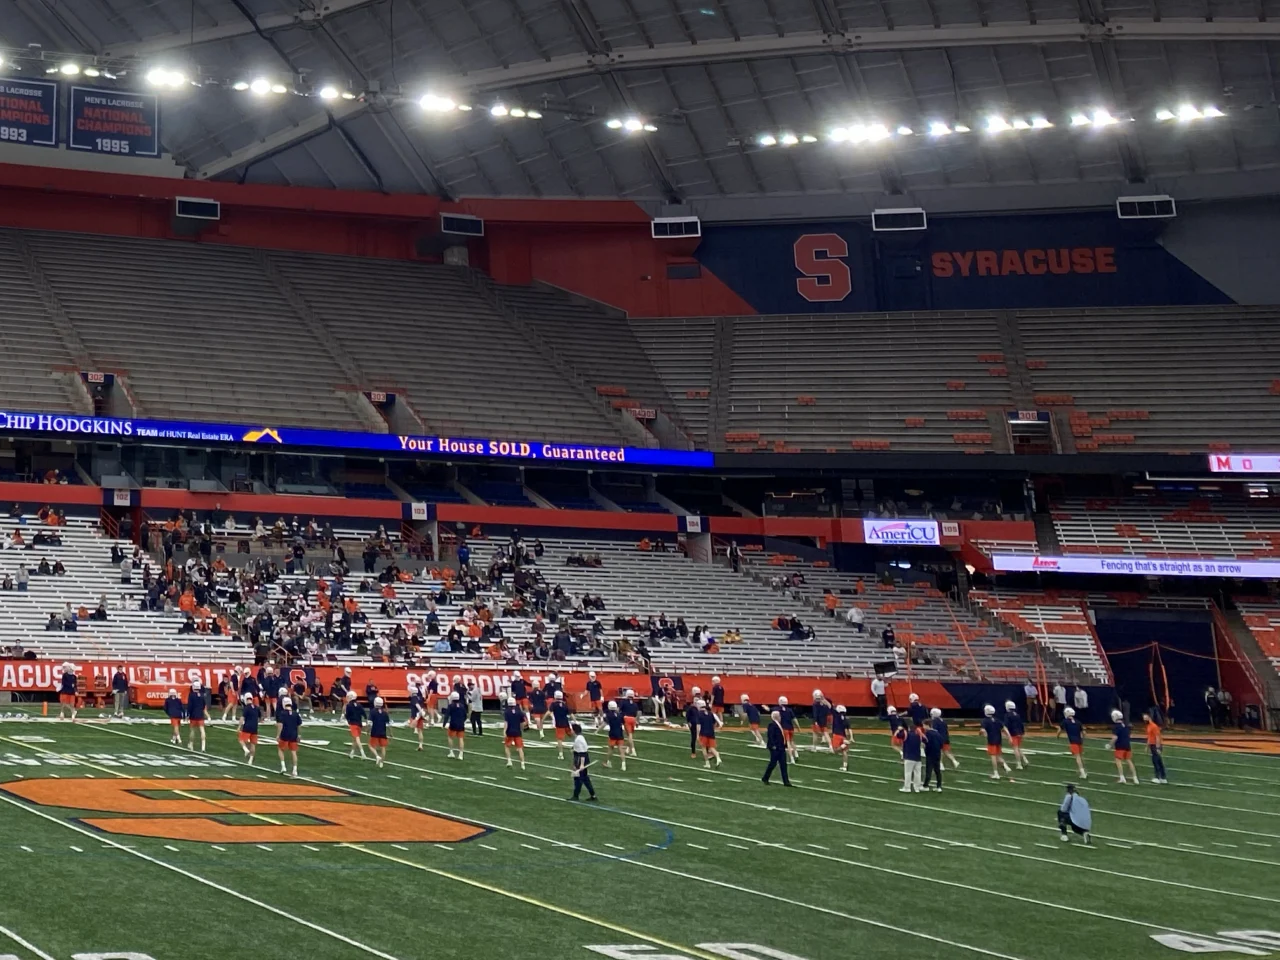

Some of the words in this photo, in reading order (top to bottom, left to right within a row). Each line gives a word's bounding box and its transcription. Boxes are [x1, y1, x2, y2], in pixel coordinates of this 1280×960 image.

[6, 86, 42, 97] LACROSSE
[84, 96, 107, 105] MEN'S
[108, 99, 144, 109] LACROSSE
[83, 107, 146, 124] NATIONAL
[76, 118, 152, 137] CHAMPIONS
[96, 138, 130, 154] 1995
[793, 233, 852, 302] S
[931, 246, 1118, 278] SYRACUSE
[88, 374, 103, 382] 302
[372, 393, 386, 401] 303
[136, 428, 158, 437] TEAM
[166, 430, 186, 438] HUNT
[188, 431, 200, 439] Real
[202, 432, 219, 440] Estate
[220, 433, 234, 441] ERA
[399, 436, 433, 451] Your
[439, 438, 483, 454] House
[489, 441, 536, 458] SOLD,
[542, 445, 625, 462] Guaranteed
[1216, 456, 1232, 470] M
[869, 526, 935, 540] AmeriCU
[1101, 560, 1133, 572] Fencing
[1134, 561, 1157, 571] that's
[1160, 562, 1191, 573] straight
[1218, 565, 1242, 573] arrow
